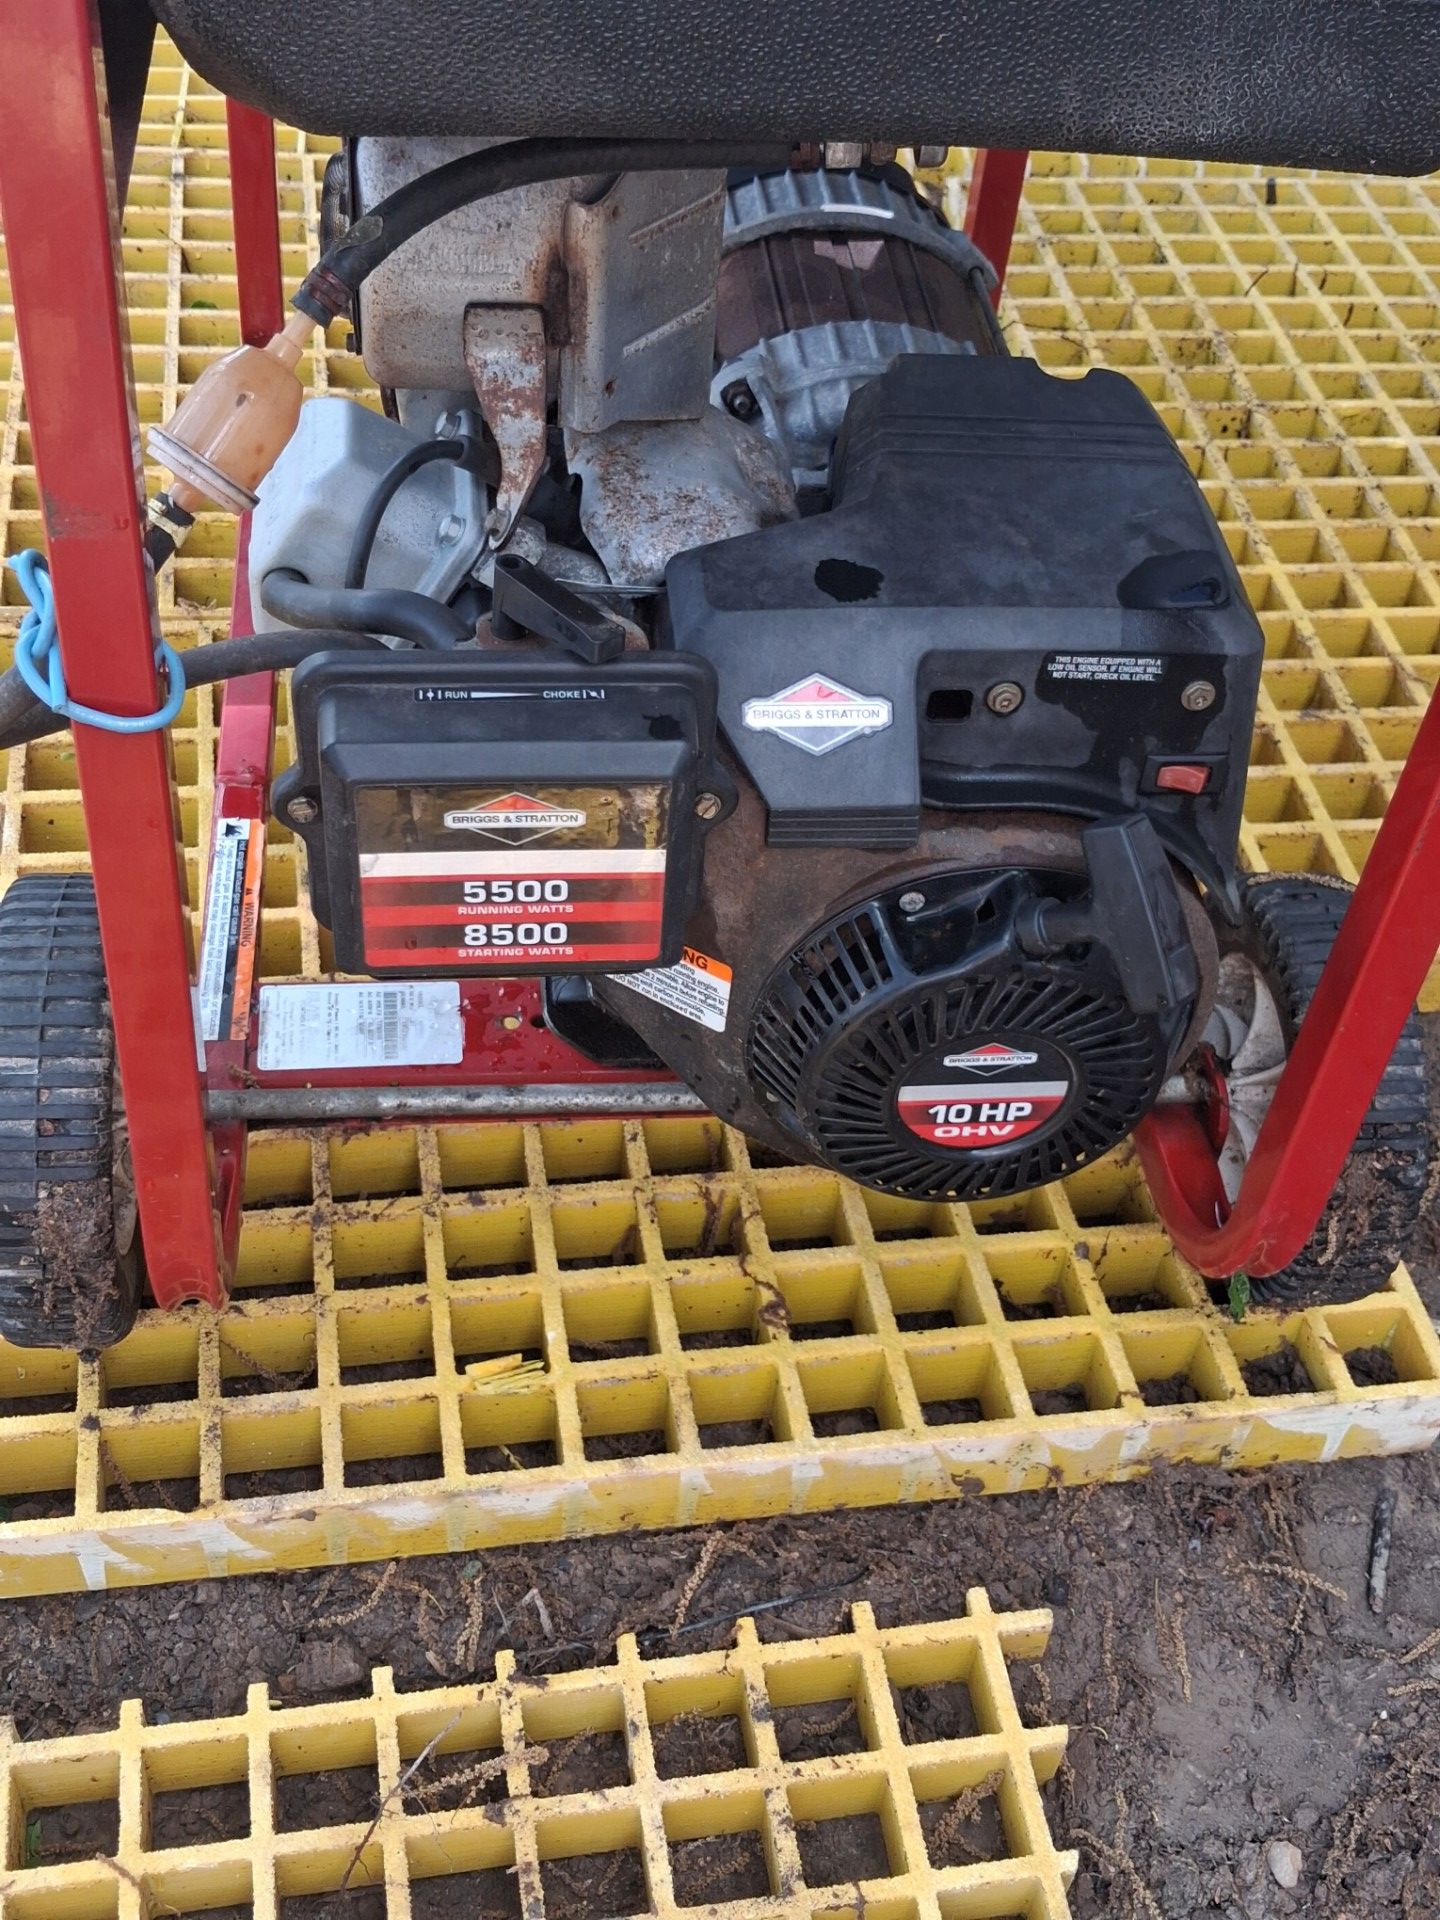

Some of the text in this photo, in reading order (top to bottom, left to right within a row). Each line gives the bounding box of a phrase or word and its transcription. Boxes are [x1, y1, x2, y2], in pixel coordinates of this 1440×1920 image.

[1072, 656, 1100, 664] ENGINE
[1100, 657, 1136, 665] EQUIPPED
[1068, 672, 1092, 680] START,
[1146, 666, 1162, 674] WILL
[444, 690, 581, 699] RUN CHOKE
[753, 708, 880, 720] BRIGGS & STRATTON
[452, 814, 579, 824] BRIGGS & STRATTON
[464, 880, 568, 904] 5500
[458, 904, 574, 915] RUNNING WATTS
[241, 902, 256, 947] WARNING
[464, 922, 568, 946] 8500
[458, 946, 574, 958] STARTING WATTS
[627, 978, 640, 988] NOT
[642, 986, 652, 996] run
[652, 990, 659, 998] in
[656, 976, 678, 992] minutes
[654, 984, 674, 1000] carbon
[682, 980, 696, 993] Allow
[698, 987, 718, 1003] engine
[718, 998, 724, 1006] to
[928, 1102, 1032, 1124] 10 HP
[934, 1124, 1015, 1138] OHV
